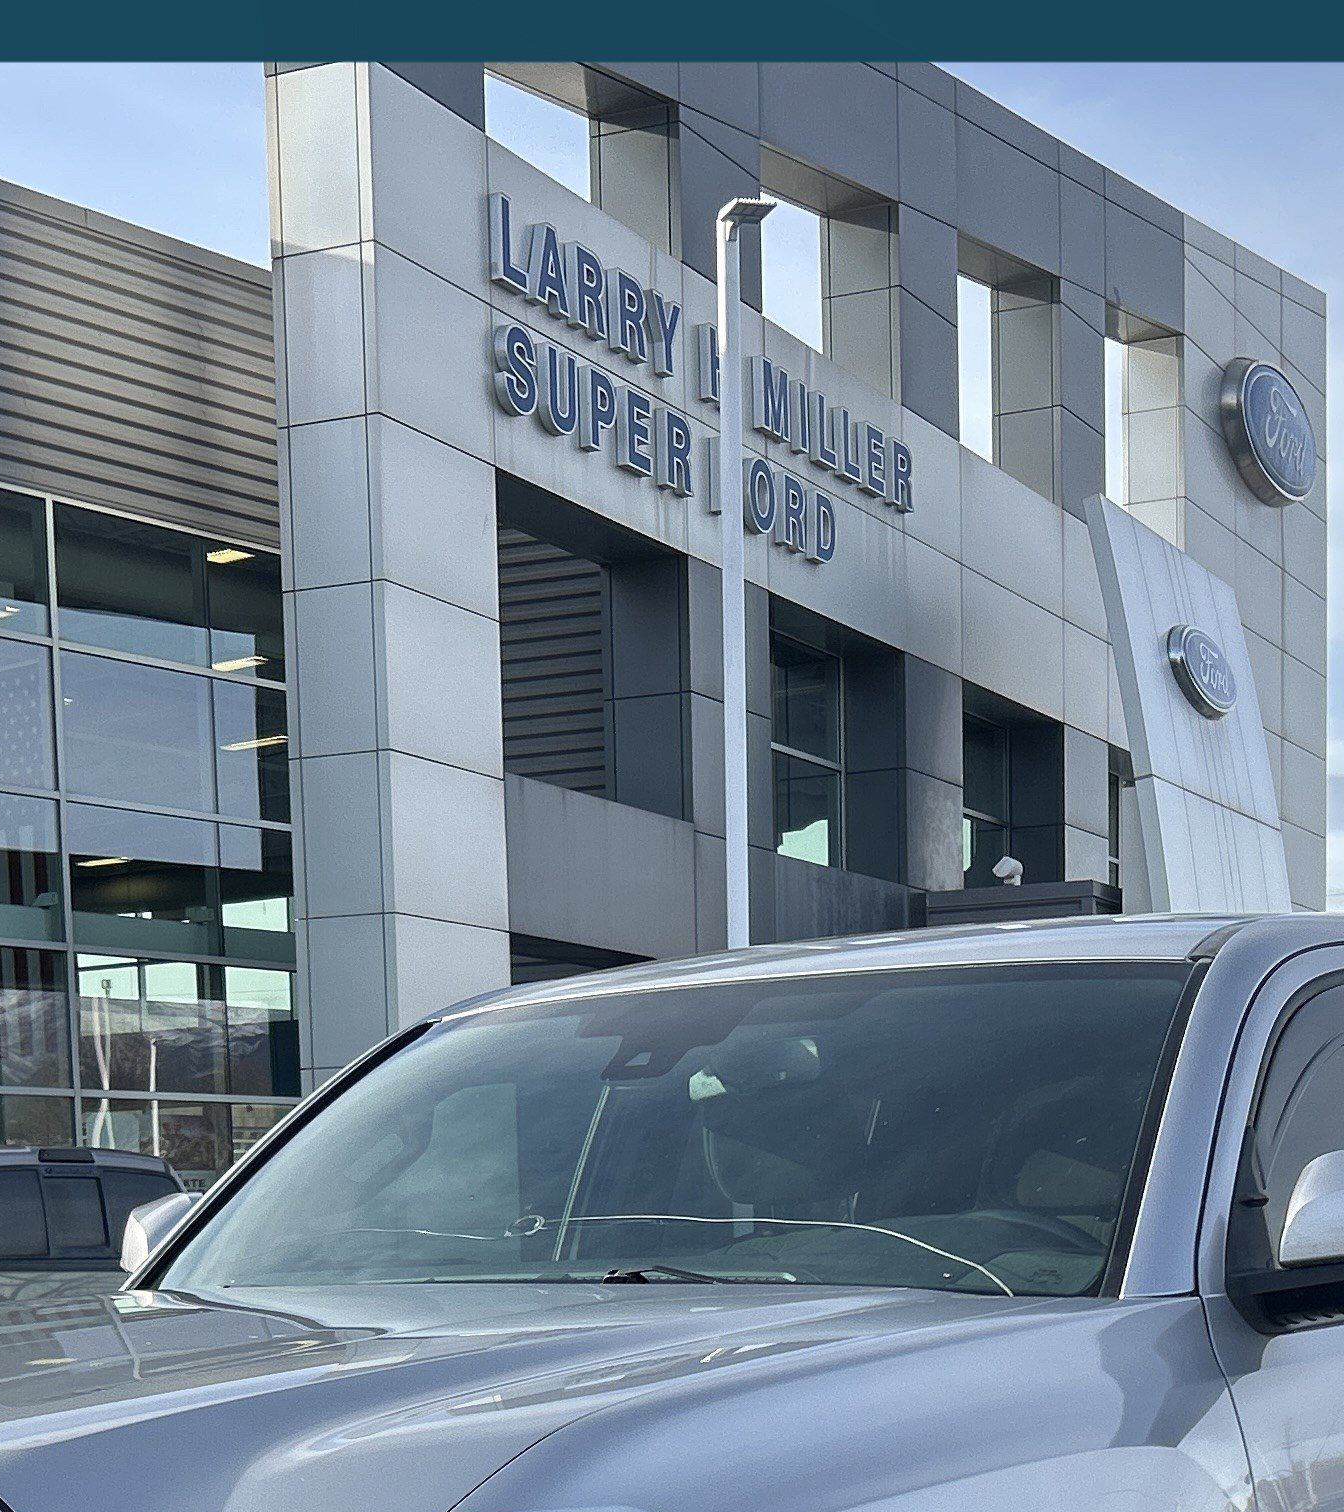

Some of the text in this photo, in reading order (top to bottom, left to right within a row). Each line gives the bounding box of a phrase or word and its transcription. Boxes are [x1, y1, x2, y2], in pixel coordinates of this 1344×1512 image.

[492, 193, 682, 378] LARRY
[754, 355, 914, 514] MILLER
[1265, 386, 1308, 478] Ford
[496, 324, 837, 564] SUPER ORD
[1199, 642, 1230, 697] Ford
